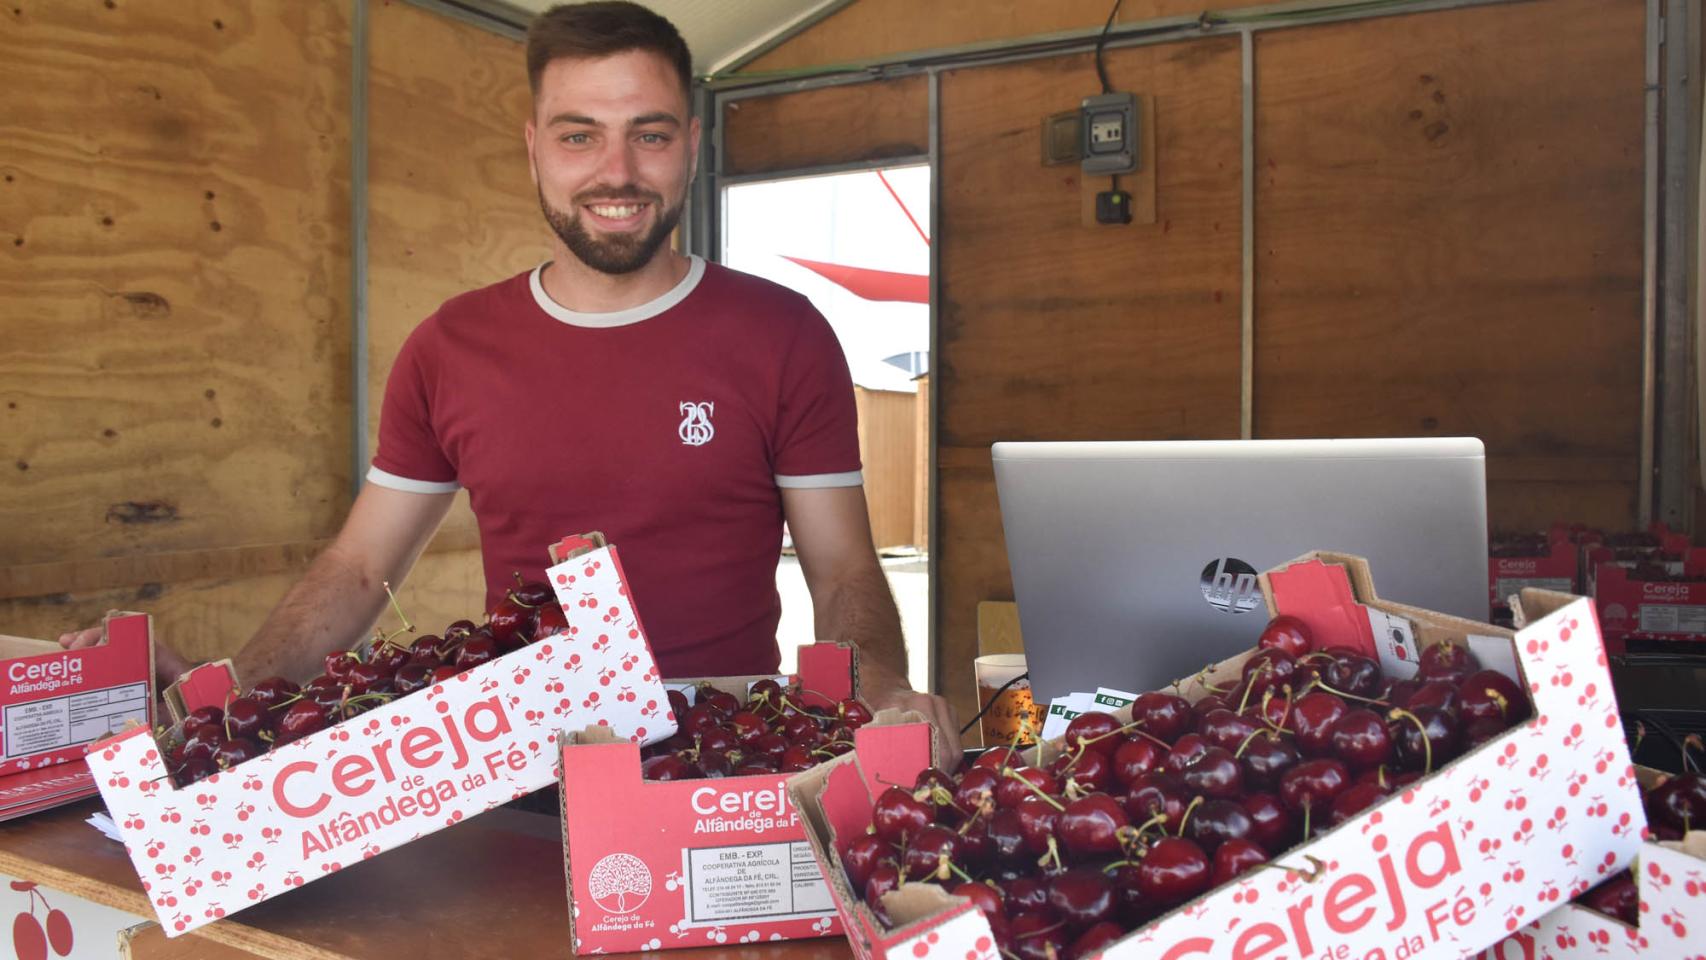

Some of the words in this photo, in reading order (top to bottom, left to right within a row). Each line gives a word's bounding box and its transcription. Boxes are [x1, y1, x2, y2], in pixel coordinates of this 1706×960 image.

[1499, 559, 1536, 570] Cereja
[1211, 557, 1257, 614] hp
[1643, 583, 1689, 596] Cereja
[8, 655, 83, 682] Cereja
[9, 680, 61, 695] Alfândega
[70, 674, 83, 685] Fé
[272, 695, 512, 818] Cereja
[401, 773, 425, 792] de
[300, 778, 457, 861] Alfândega
[461, 771, 487, 792] da
[483, 742, 528, 781] Fé
[749, 810, 762, 818] de
[694, 816, 774, 834] Alfândega
[776, 818, 788, 828] da
[719, 852, 740, 860] EMB.
[747, 851, 763, 859] EXP.
[702, 862, 747, 870] COOPERATIVA
[591, 923, 632, 932] Alfândega
[633, 921, 644, 929] da
[603, 915, 629, 923] Cereja
[1395, 935, 1425, 960] da
[1425, 886, 1477, 942] Fé
